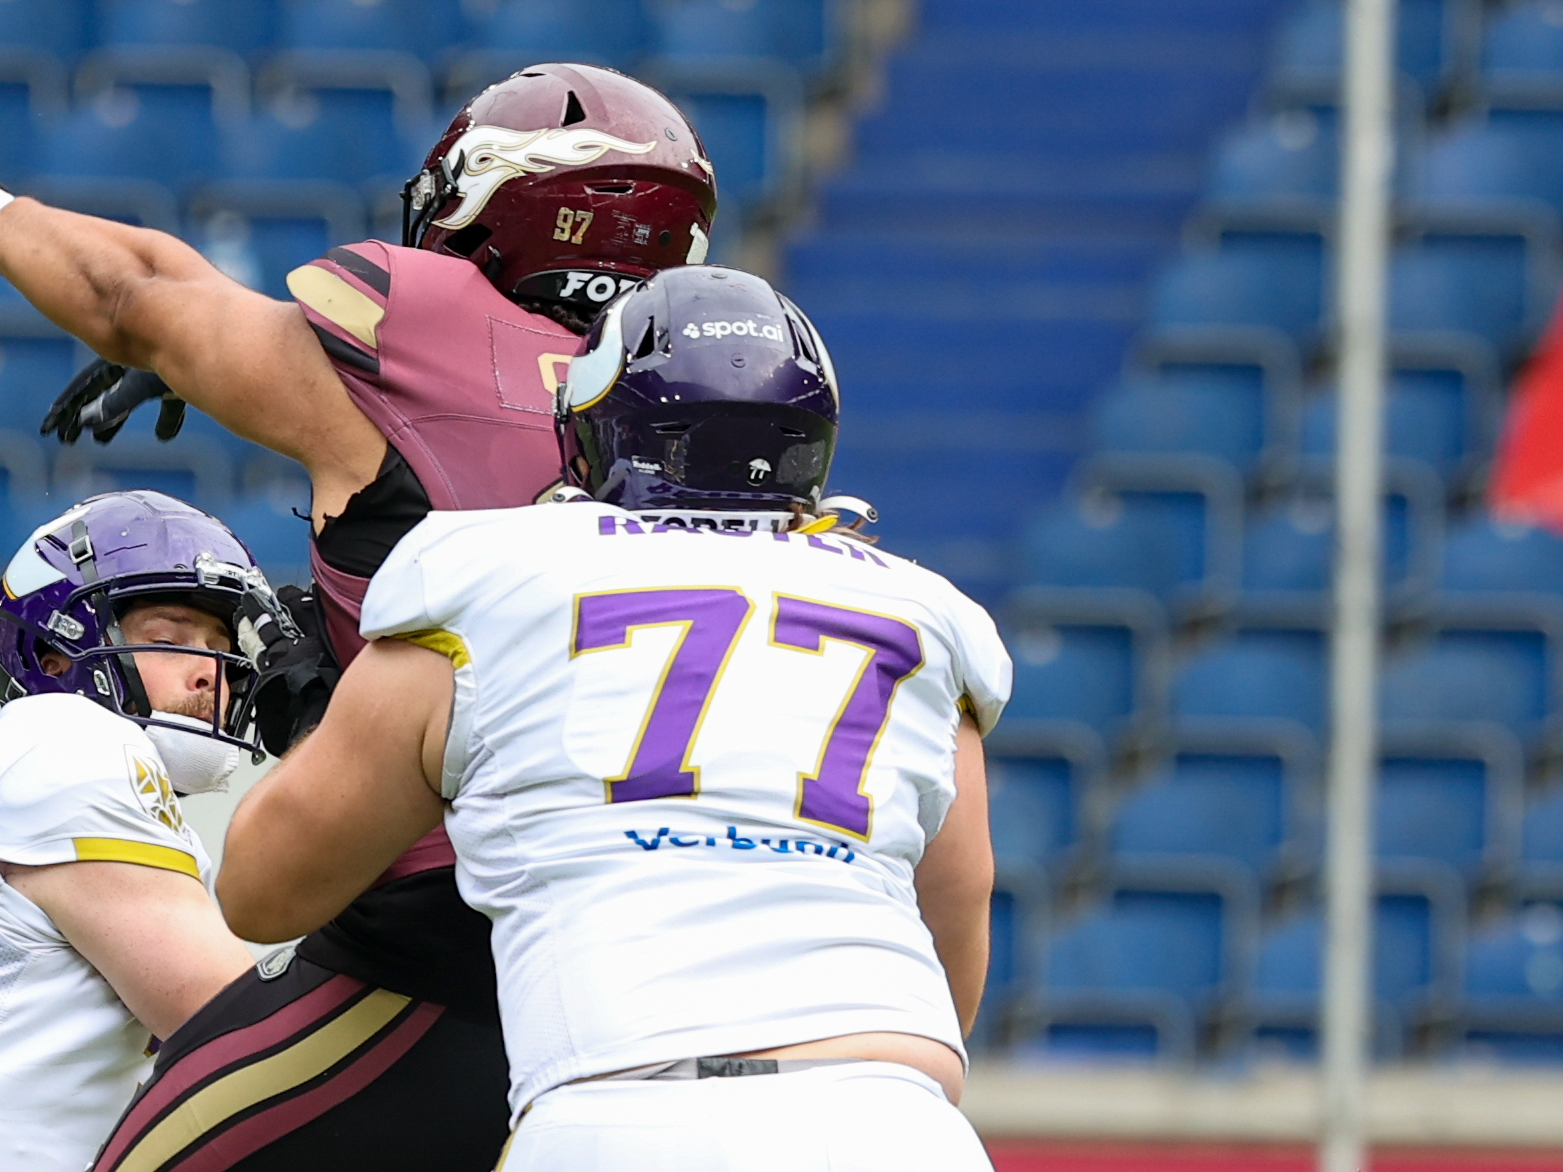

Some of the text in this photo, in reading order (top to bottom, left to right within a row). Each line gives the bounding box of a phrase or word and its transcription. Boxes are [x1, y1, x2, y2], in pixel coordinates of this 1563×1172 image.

[553, 206, 594, 245] 97
[702, 320, 784, 342] spot.ai
[570, 584, 925, 842] 77
